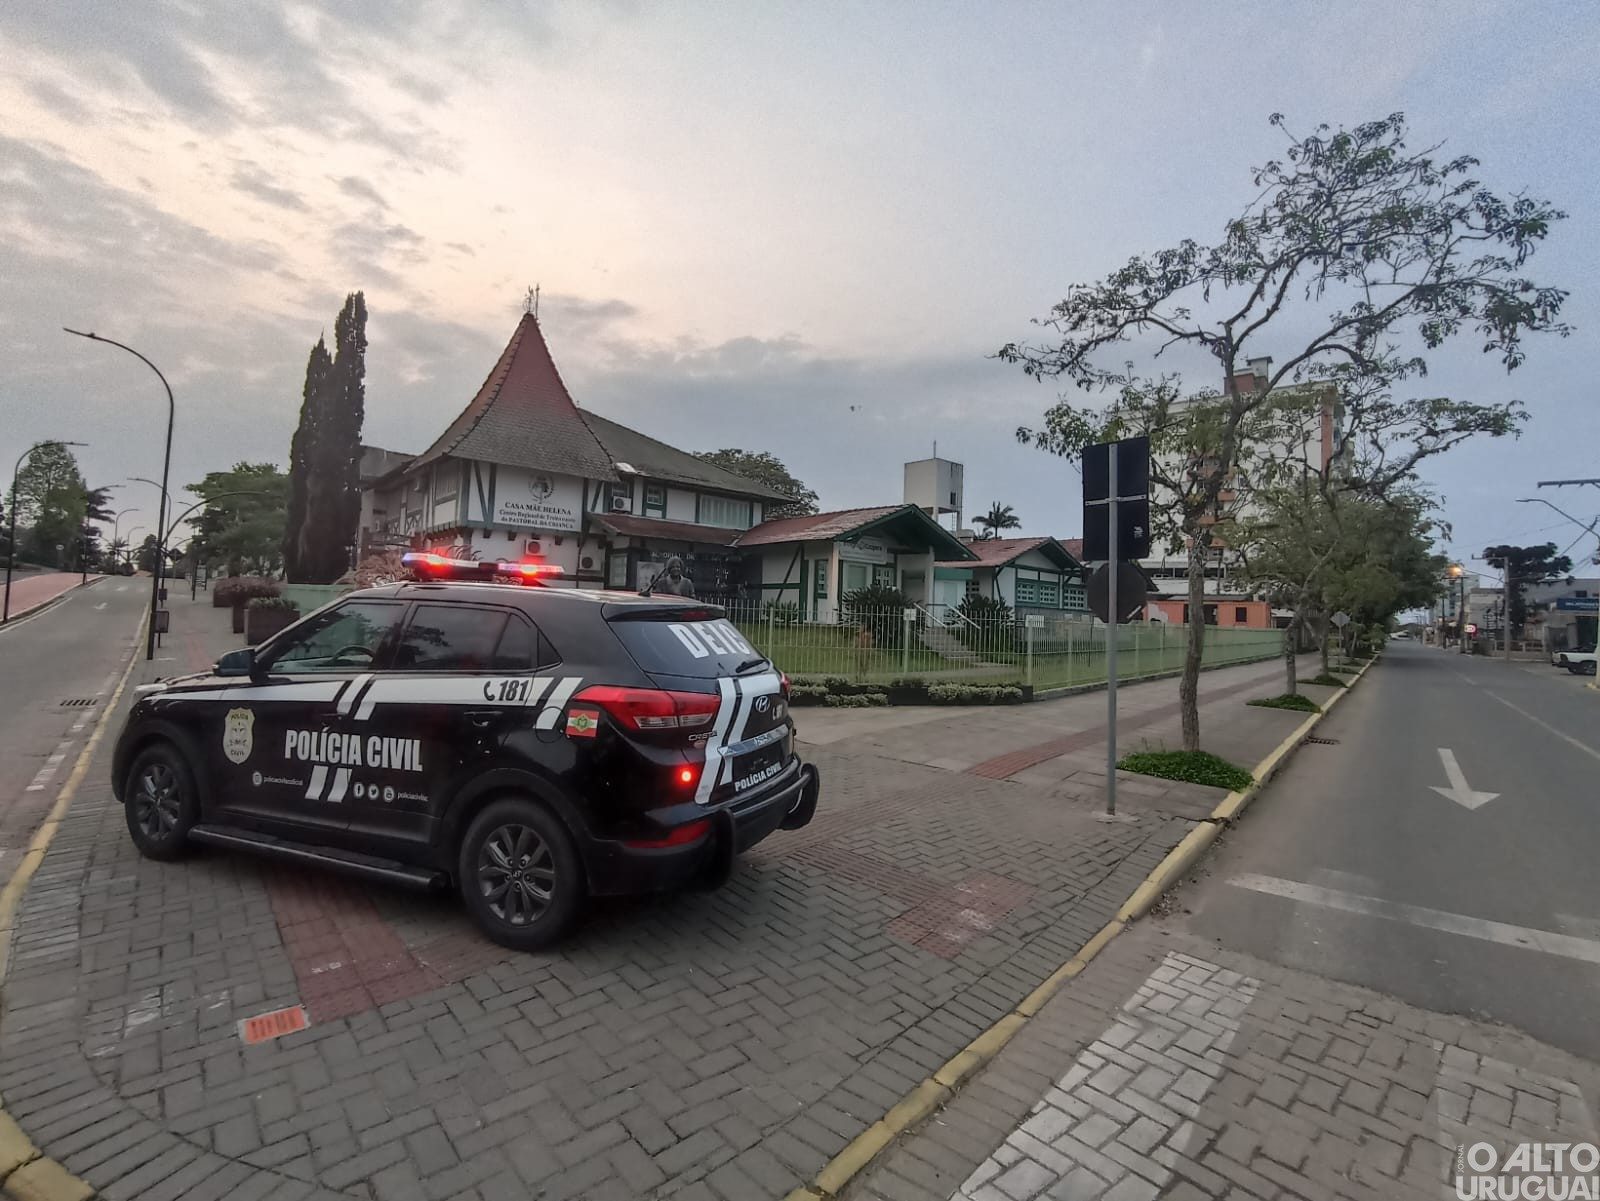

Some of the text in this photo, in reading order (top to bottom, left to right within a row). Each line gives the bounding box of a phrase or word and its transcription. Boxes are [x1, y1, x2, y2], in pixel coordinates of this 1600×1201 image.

[505, 502, 524, 510] CASA
[543, 506, 572, 516] HELENA
[508, 517, 538, 525] PASTORAL
[667, 623, 750, 658] DEIC
[498, 679, 529, 701] 181
[285, 726, 423, 772] POLÍCIA CIVIL
[734, 762, 782, 792] POLÍCIA CIVIL
